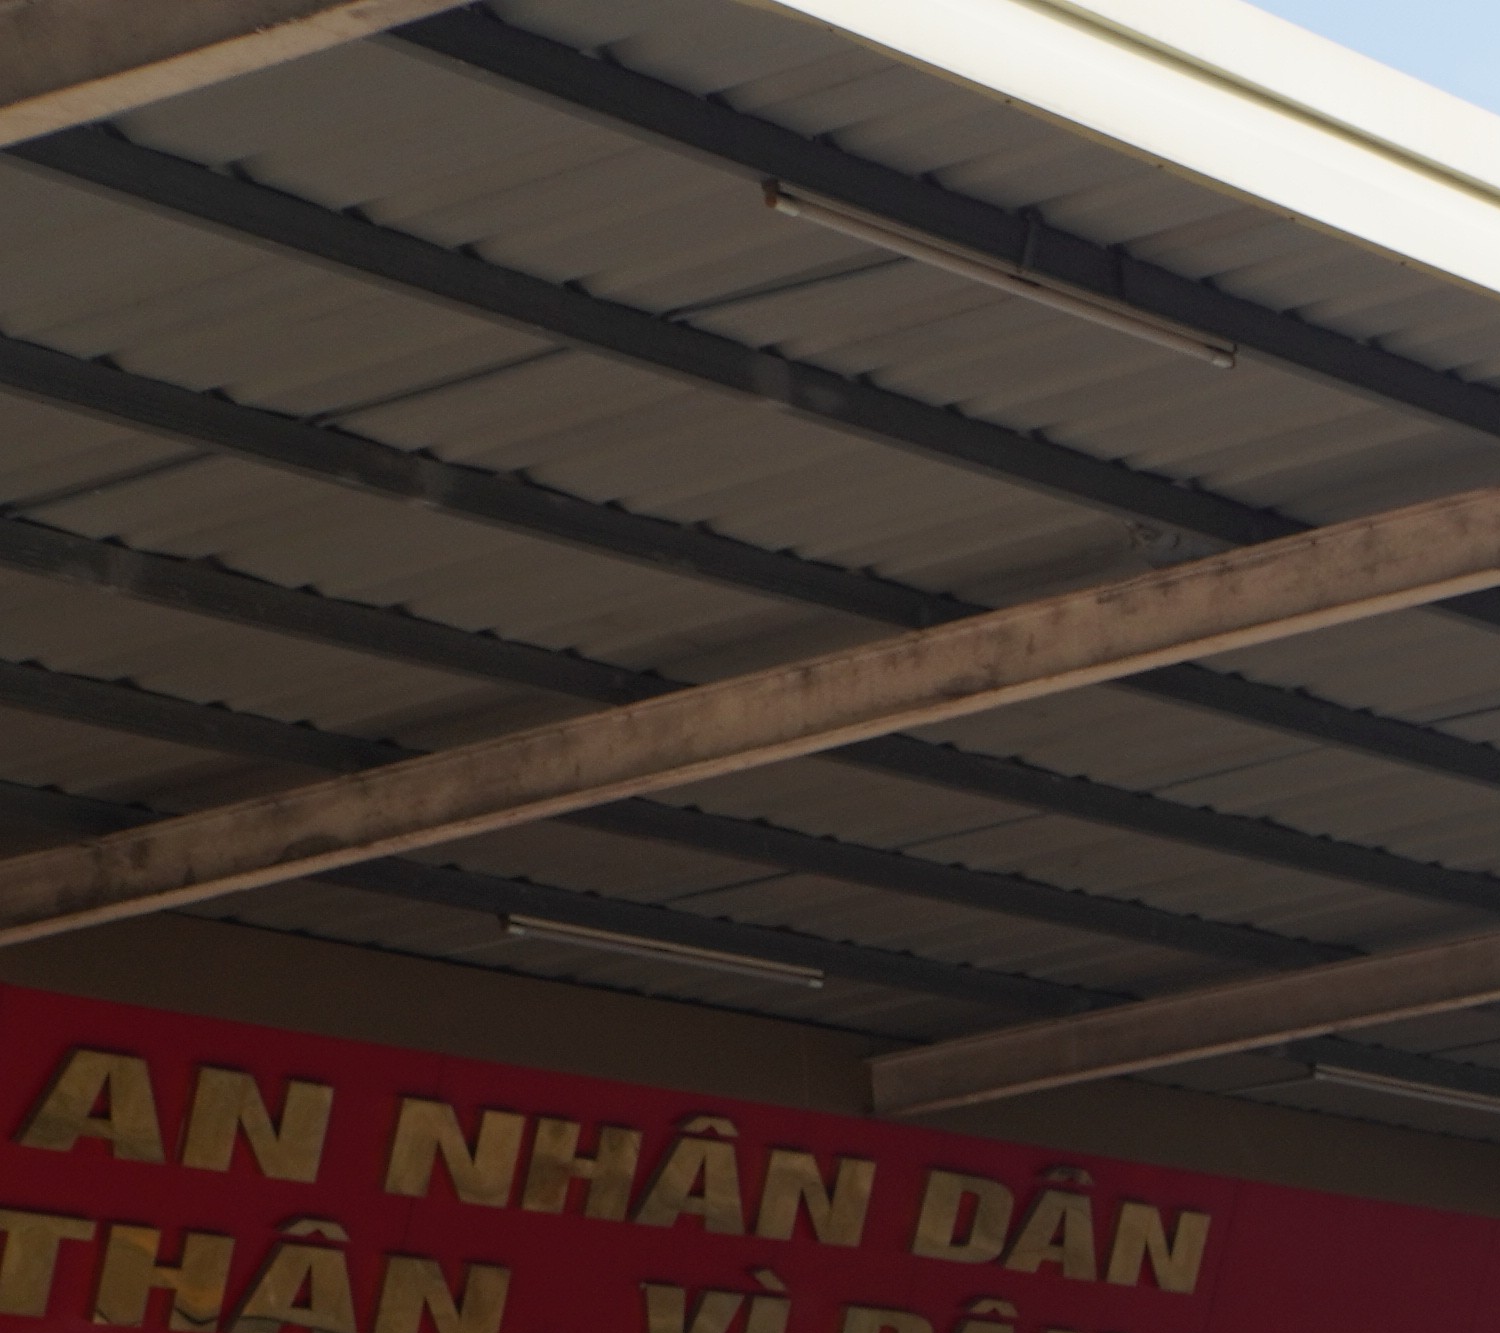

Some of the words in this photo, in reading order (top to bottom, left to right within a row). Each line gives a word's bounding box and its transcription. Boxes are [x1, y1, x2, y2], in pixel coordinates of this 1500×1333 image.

[17, 1048, 334, 1184] AN
[384, 1098, 875, 1249] NHÂN
[911, 1166, 1212, 1294] DÂN
